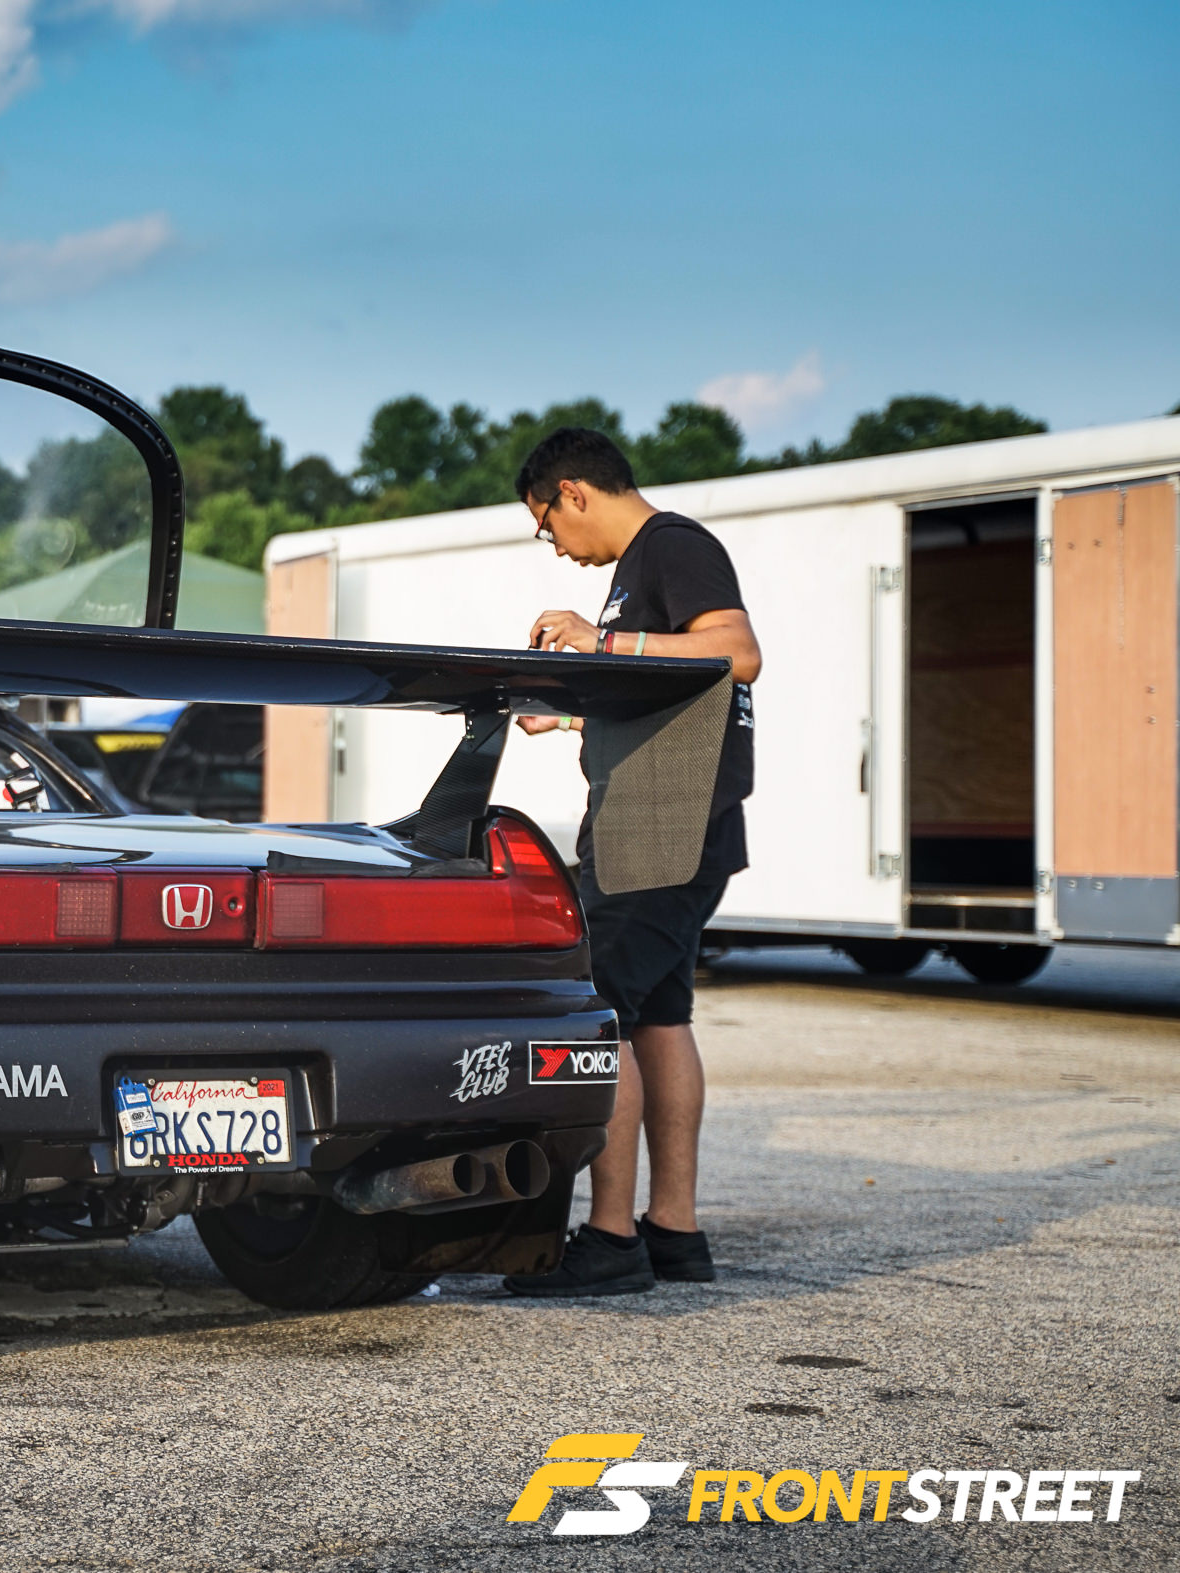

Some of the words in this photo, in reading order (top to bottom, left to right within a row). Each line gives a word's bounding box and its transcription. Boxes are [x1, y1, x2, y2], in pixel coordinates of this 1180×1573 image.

[453, 1041, 512, 1077] VTEC
[151, 1081, 258, 1108] California
[262, 1083, 279, 1092] 2021
[449, 1067, 510, 1103] CLUB
[167, 1153, 250, 1167] HONDA
